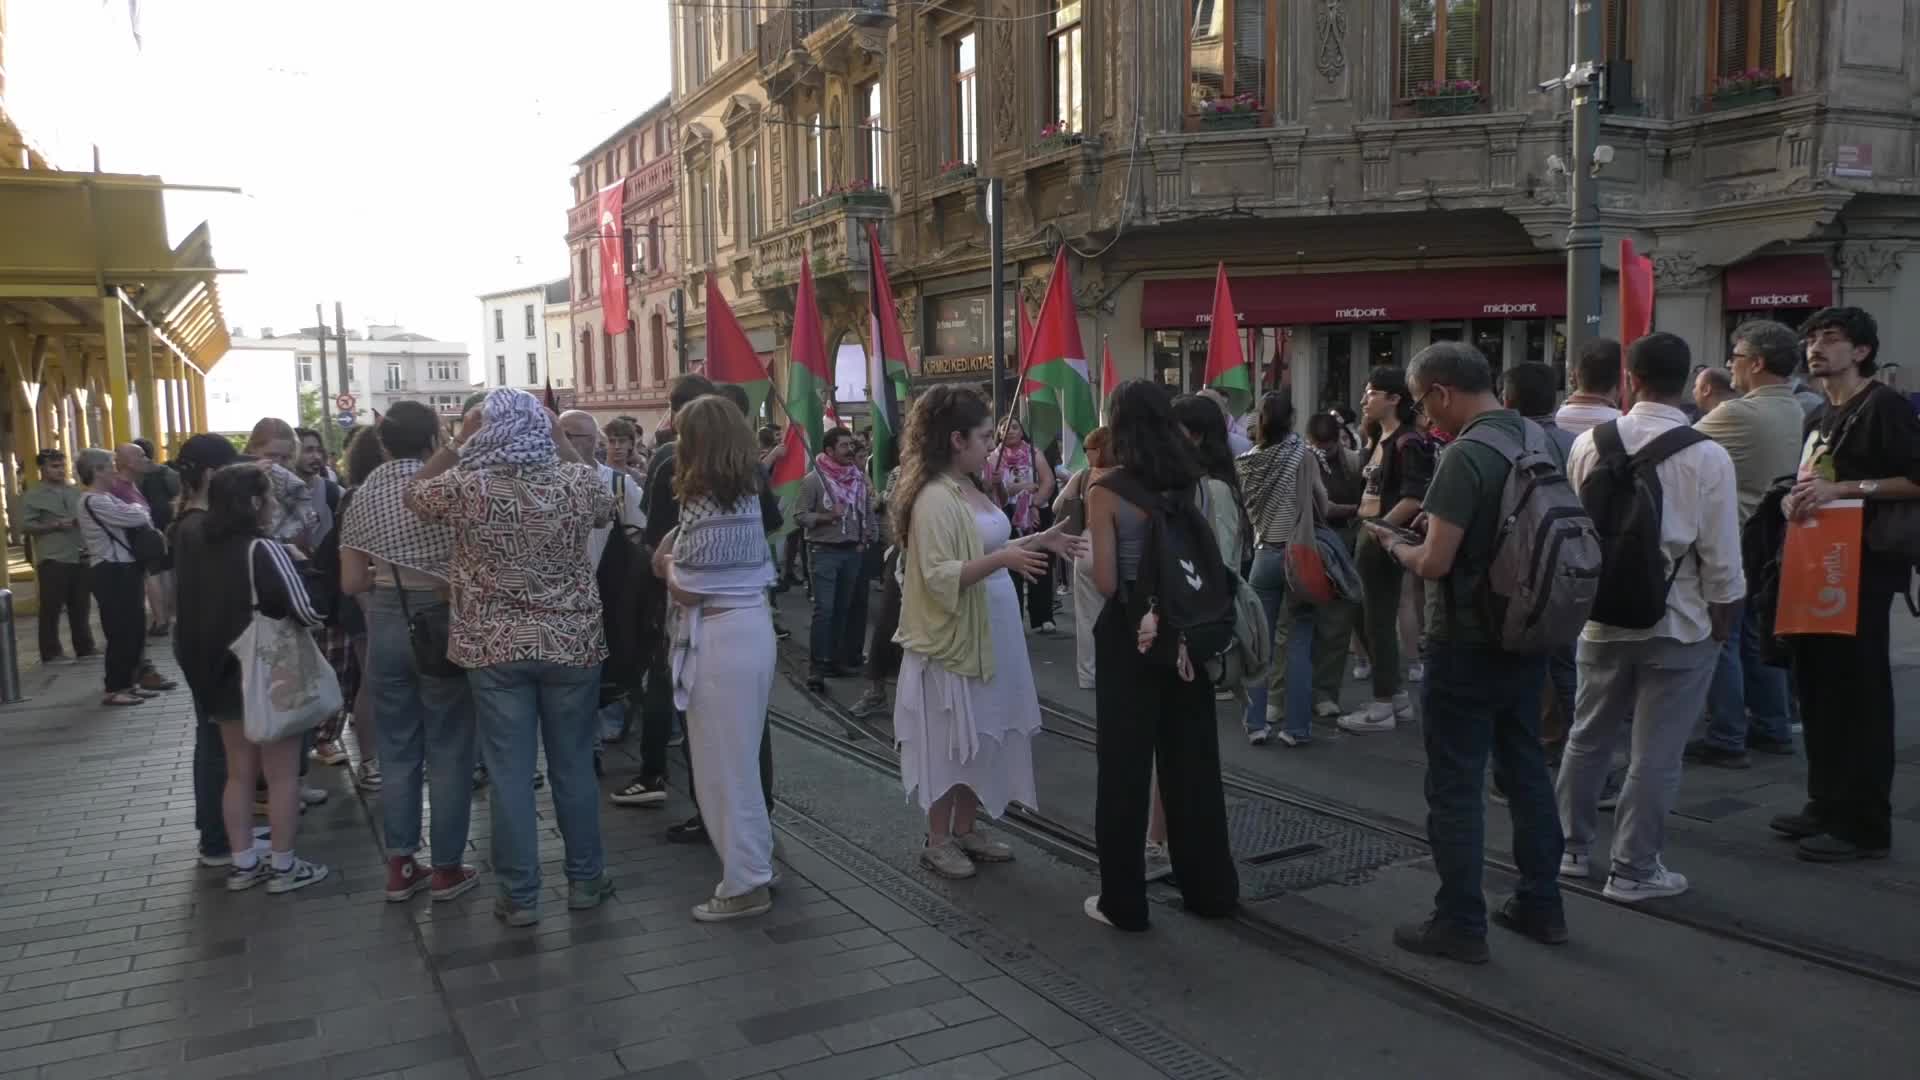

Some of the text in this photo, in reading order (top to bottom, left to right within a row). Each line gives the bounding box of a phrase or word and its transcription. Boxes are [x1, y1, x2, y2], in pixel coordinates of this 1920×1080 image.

[1751, 293, 1808, 306] midpoint
[1335, 307, 1386, 319] midpoint
[1483, 302, 1536, 314] midpoint
